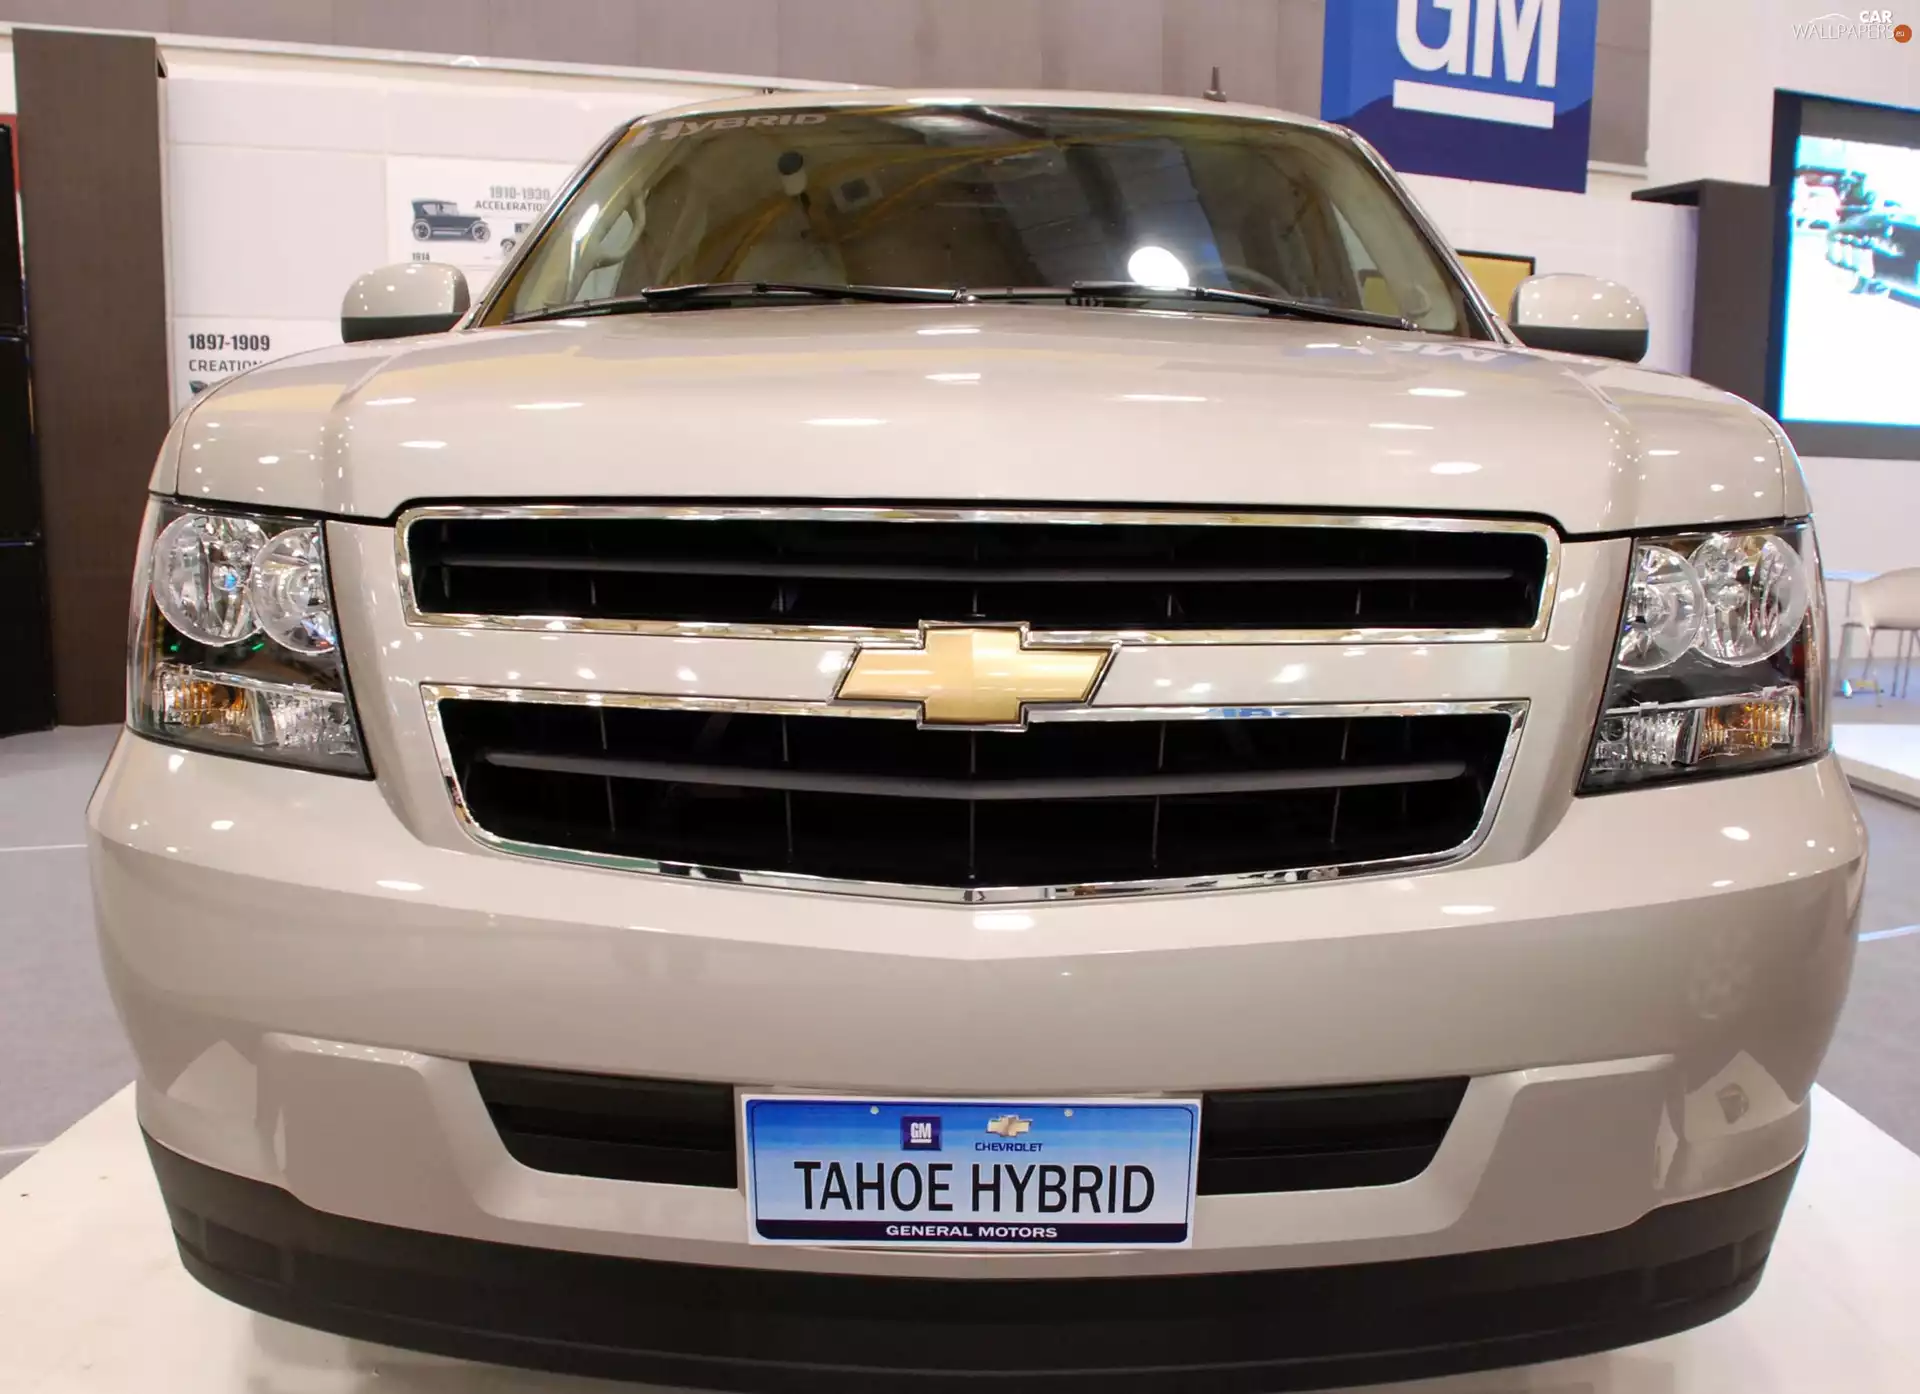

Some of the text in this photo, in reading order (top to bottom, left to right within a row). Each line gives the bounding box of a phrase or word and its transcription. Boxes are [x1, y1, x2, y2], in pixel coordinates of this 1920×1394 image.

[1396, 0, 1560, 88] GM
[475, 200, 545, 212] ACCELERATIO
[188, 333, 271, 351] 1897-1909
[910, 1122, 932, 1140] GM
[975, 1142, 1043, 1152] CHEVROLET
[794, 1161, 1155, 1214] TAHOE HYBRID
[886, 1225, 1058, 1238] GENERAL MOTORS
